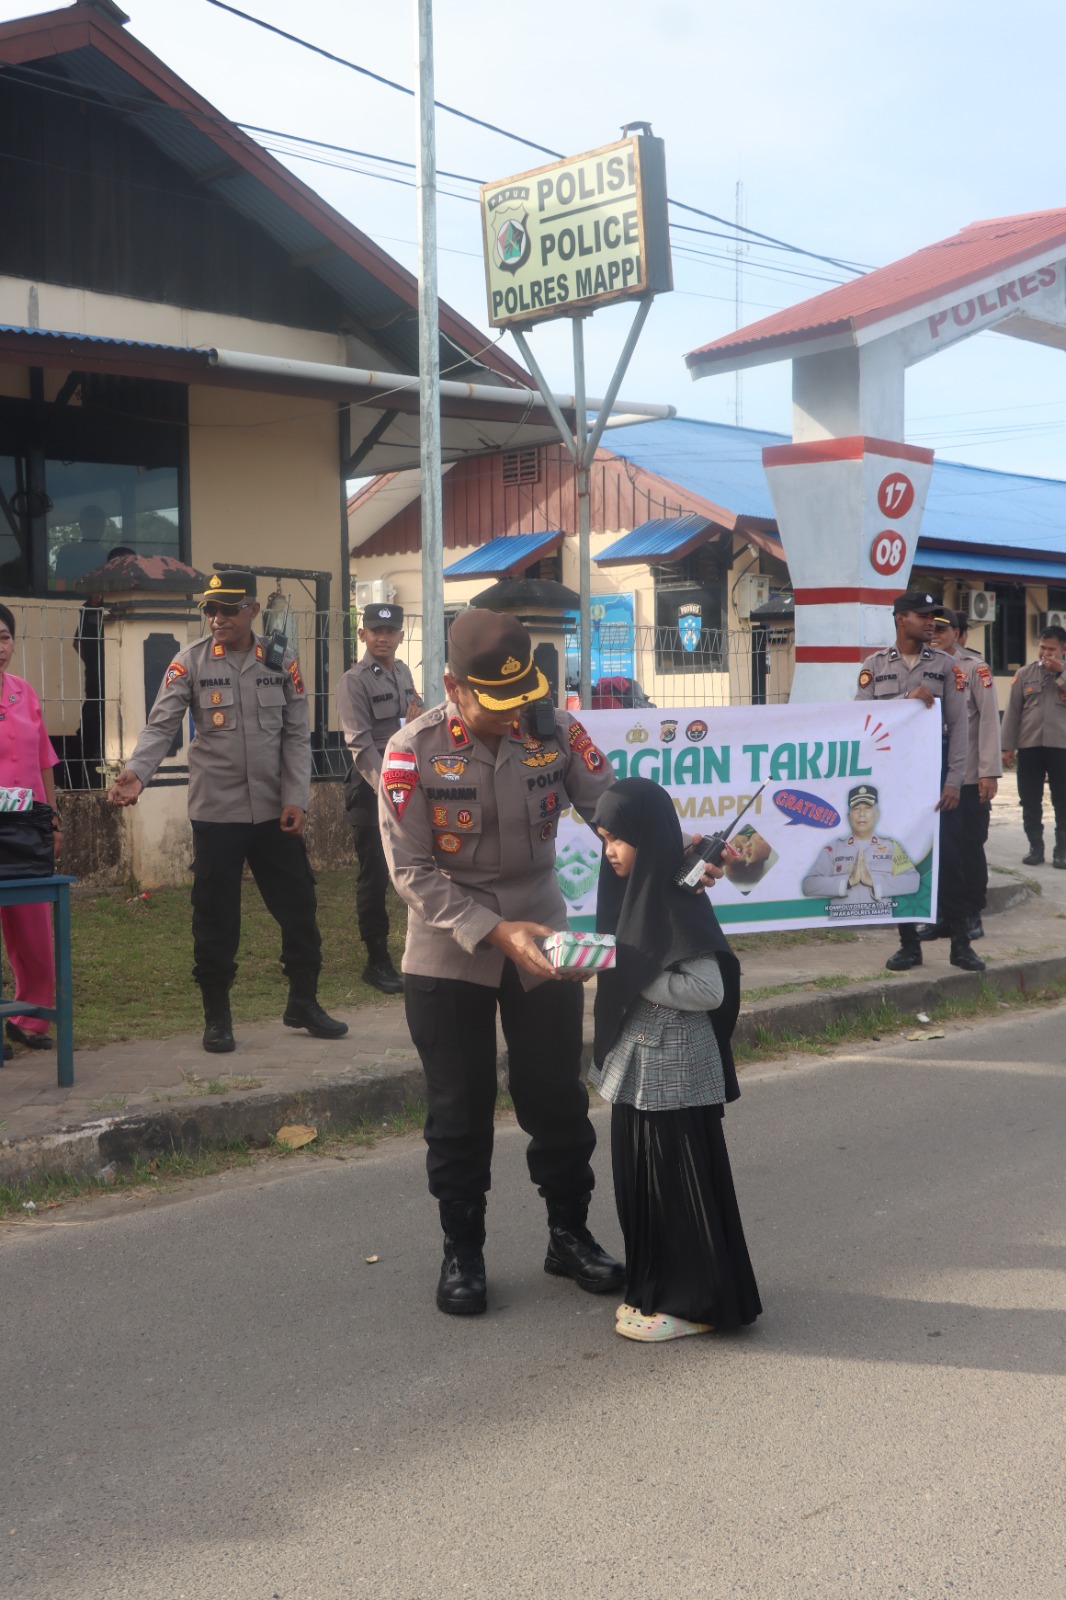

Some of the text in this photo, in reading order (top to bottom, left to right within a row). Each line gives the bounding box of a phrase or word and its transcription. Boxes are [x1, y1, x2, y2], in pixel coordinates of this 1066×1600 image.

[491, 190, 526, 206] PAPUA
[541, 210, 638, 267] POLICE
[493, 255, 641, 317] POLRES MAPPI
[884, 481, 906, 510] 17
[876, 539, 902, 566] 08
[605, 741, 872, 785] AGIAN TAKJIL
[775, 791, 838, 826] GRATIS!!!
